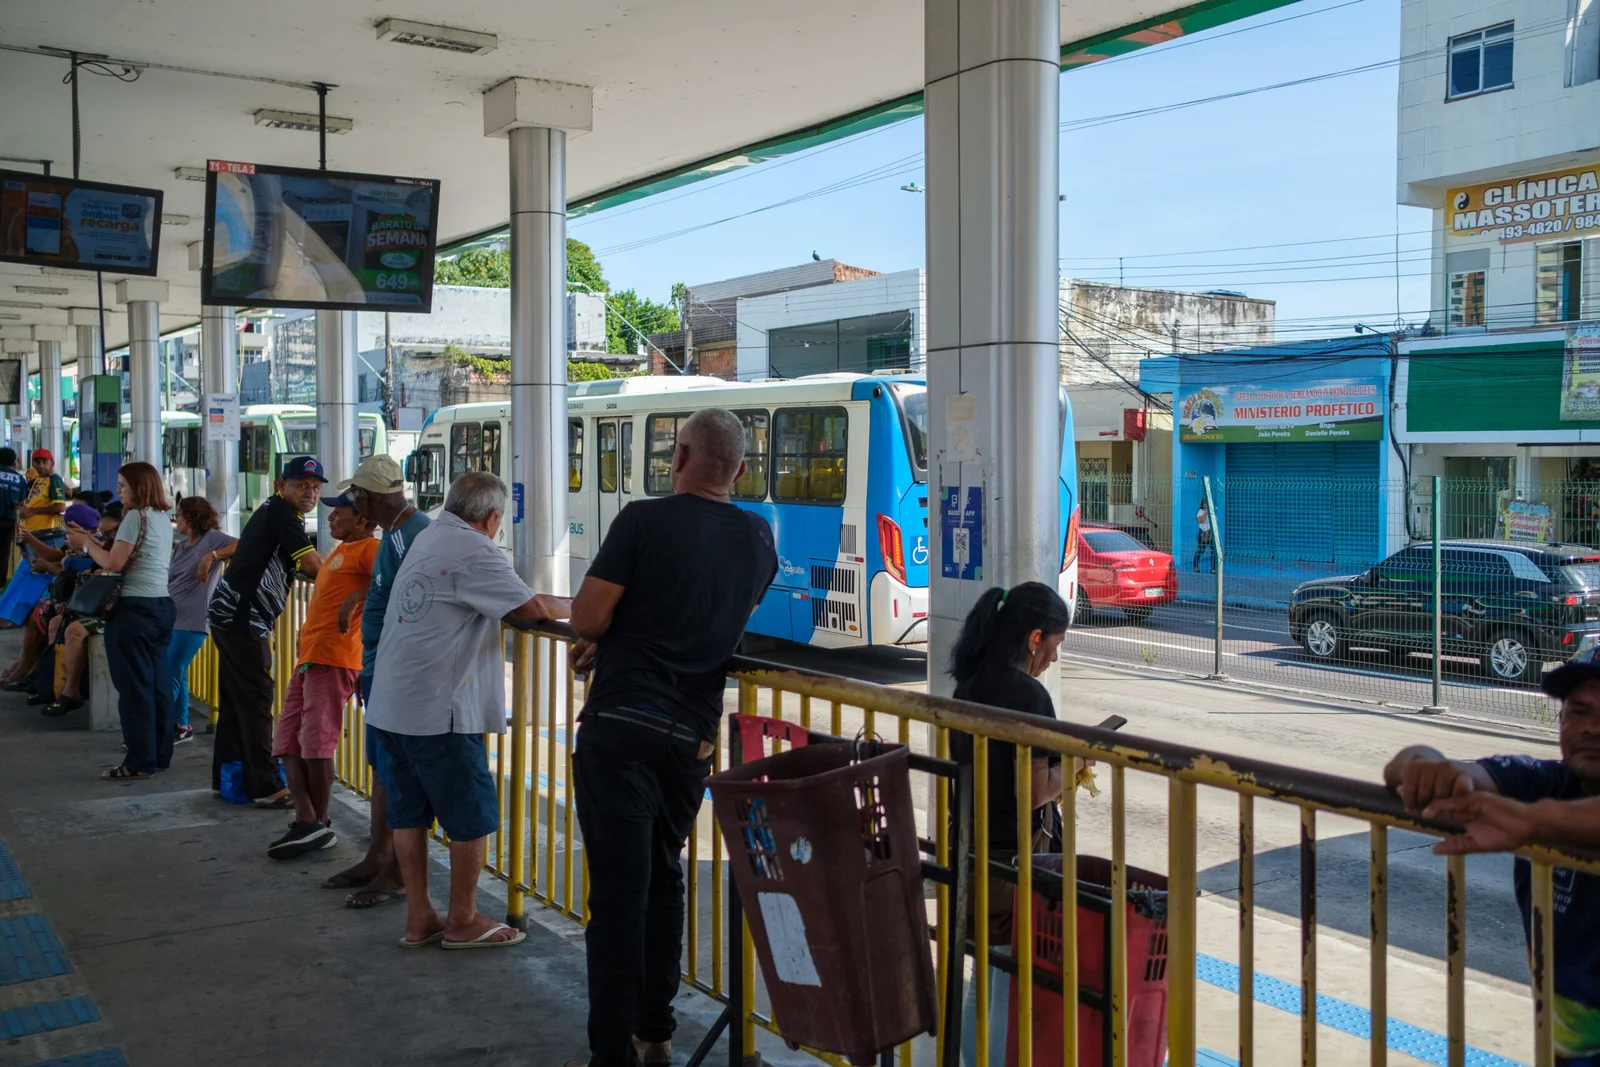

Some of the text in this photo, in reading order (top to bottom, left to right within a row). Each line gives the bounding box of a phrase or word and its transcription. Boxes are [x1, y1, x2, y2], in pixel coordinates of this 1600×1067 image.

[209, 160, 219, 171] T1
[227, 162, 247, 173] TELA
[249, 164, 255, 174] 2
[1483, 171, 1599, 207] CLÍNICA
[1454, 191, 1600, 231] MASSOTER
[80, 217, 140, 233] recarga
[372, 220, 412, 231] BARATO
[367, 231, 428, 248] SEMANA
[1290, 388, 1322, 400] SEMEANDO
[1329, 386, 1348, 397] REINO
[1350, 386, 1358, 396] DE
[1360, 385, 1376, 396] DEUS
[1234, 400, 1375, 419] MINISTÉRIO PROFÉTICO
[1328, 429, 1350, 437] Pereira
